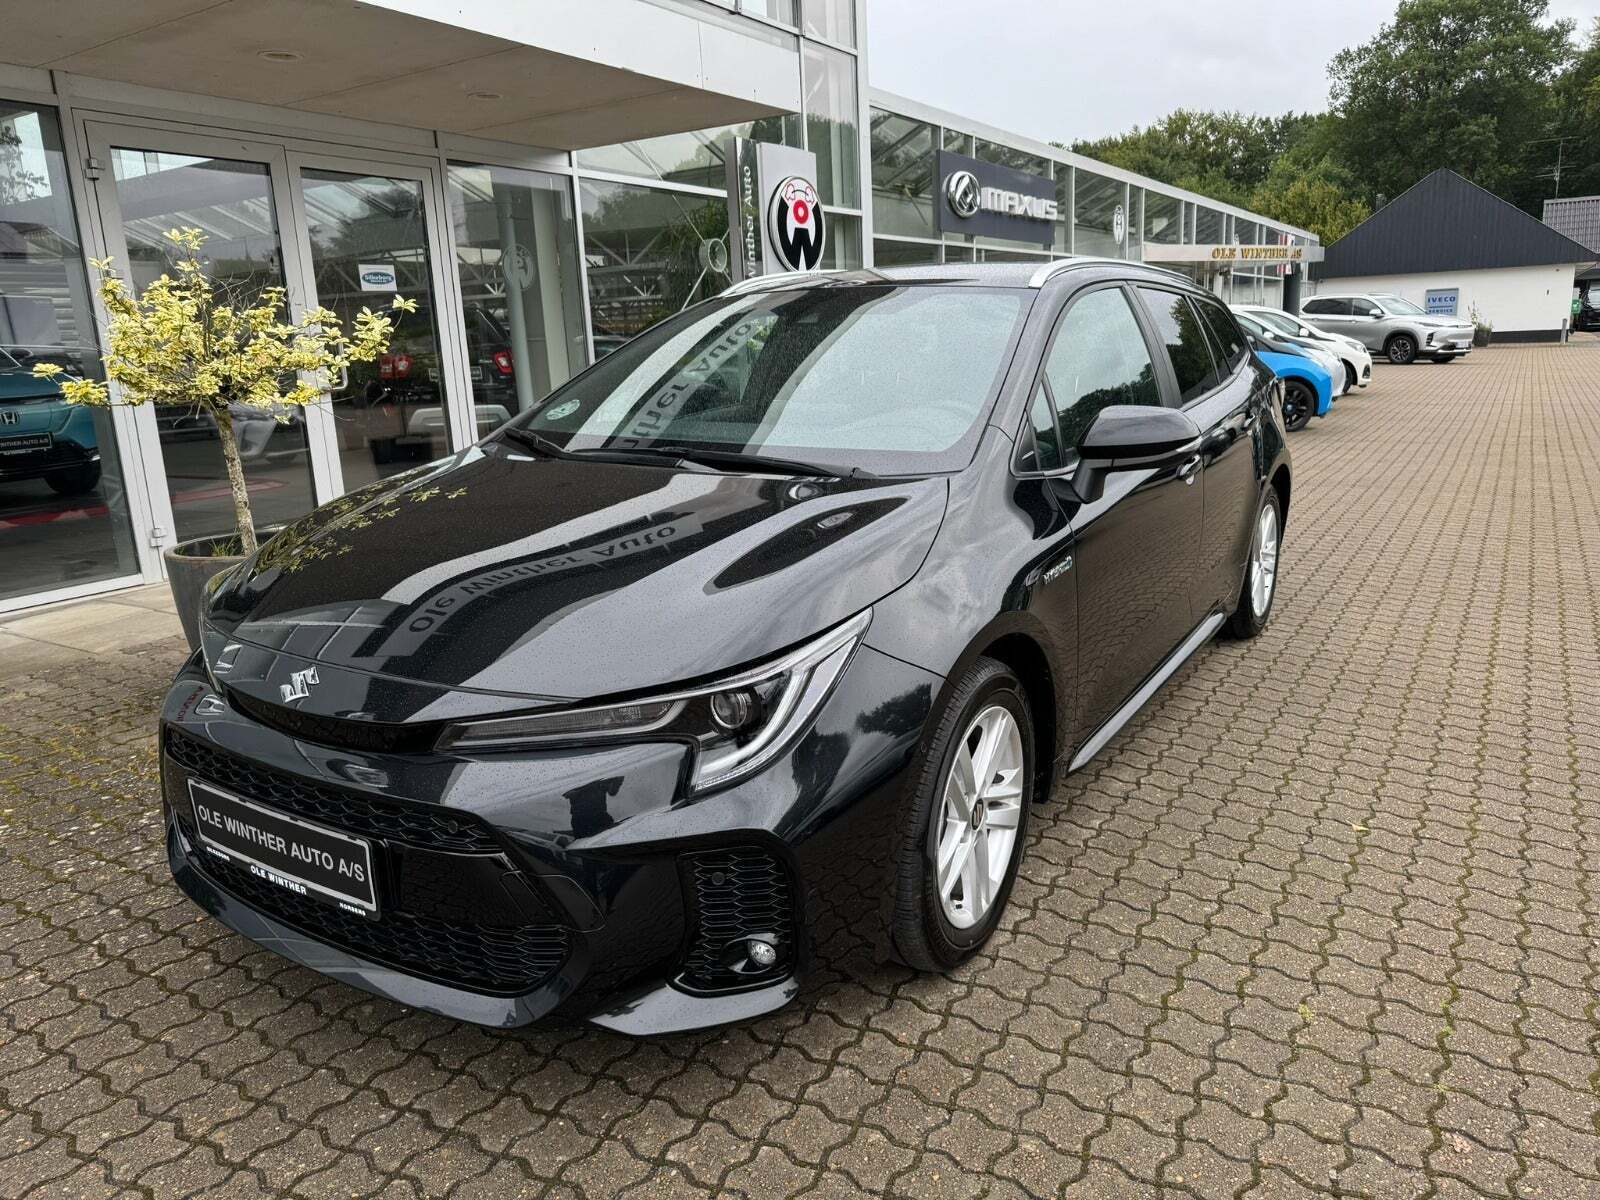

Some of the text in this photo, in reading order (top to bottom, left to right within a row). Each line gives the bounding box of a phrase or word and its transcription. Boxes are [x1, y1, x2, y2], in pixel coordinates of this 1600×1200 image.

[743, 165, 753, 208] Auto
[980, 187, 1058, 220] MAXUS
[1212, 247, 1236, 260] OLE
[1241, 247, 1287, 260] WINTHER
[198, 804, 223, 829] OLE
[223, 815, 287, 856] WINTHER
[290, 841, 334, 870] AUTO
[338, 857, 365, 882] A/S
[250, 865, 307, 895] OLE WINTHER
